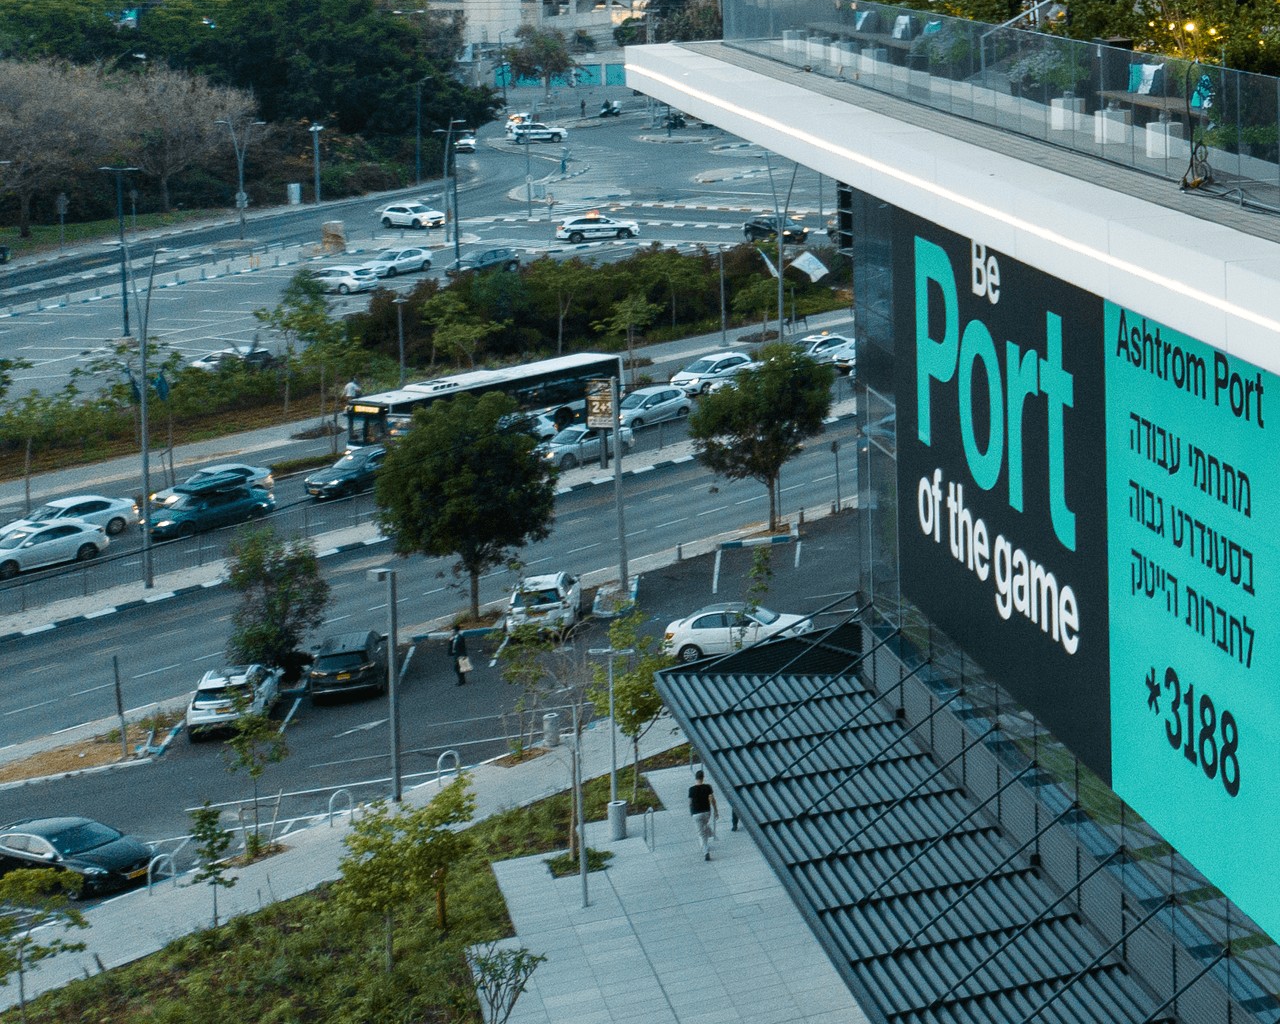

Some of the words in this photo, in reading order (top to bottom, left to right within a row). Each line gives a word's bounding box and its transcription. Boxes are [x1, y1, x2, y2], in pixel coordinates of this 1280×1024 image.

[971, 240, 1001, 305] Be
[914, 235, 1076, 553] Port
[1116, 307, 1207, 400] Ashtrom
[1213, 350, 1266, 429] Port
[1129, 411, 1181, 476] עבודה
[1188, 443, 1252, 519] מתחמי
[1128, 479, 1165, 538] גבוה
[917, 468, 943, 546] of
[946, 481, 990, 582] the
[993, 534, 1080, 655] game
[1130, 548, 1179, 618] הייטק
[1170, 505, 1256, 597] בסטנדרט
[1185, 585, 1255, 669] לחברות
